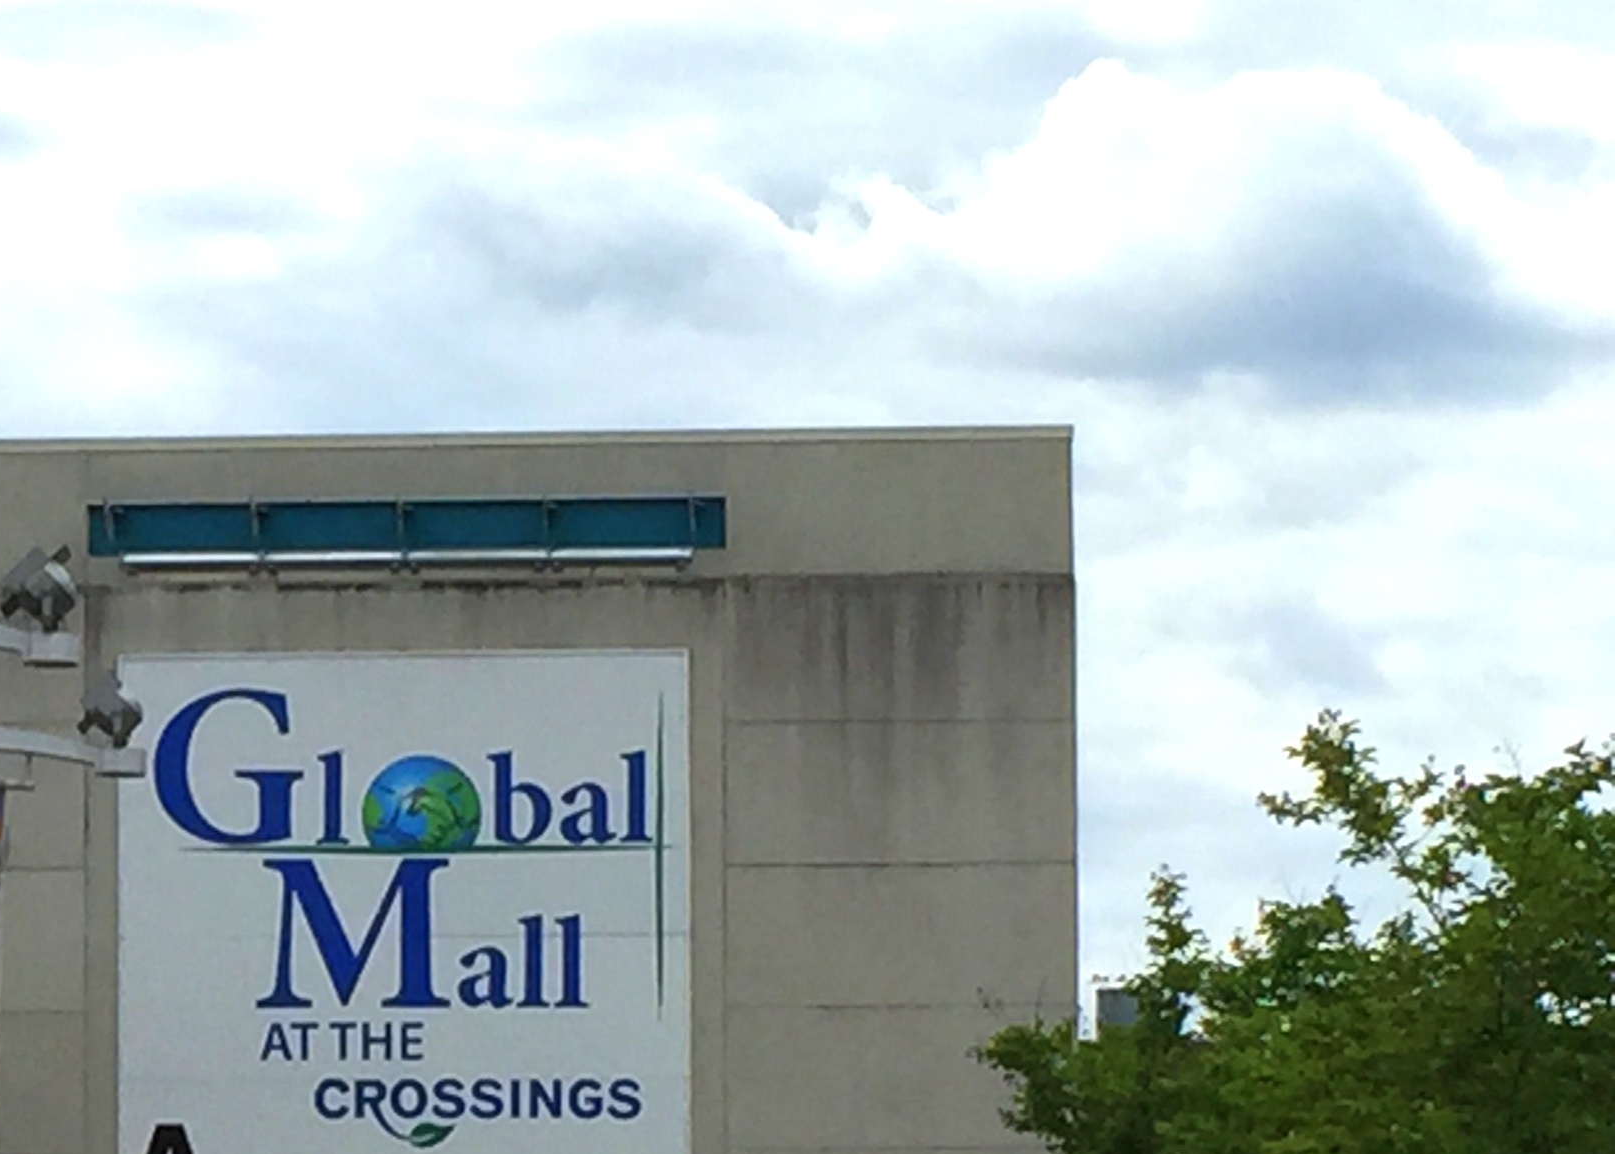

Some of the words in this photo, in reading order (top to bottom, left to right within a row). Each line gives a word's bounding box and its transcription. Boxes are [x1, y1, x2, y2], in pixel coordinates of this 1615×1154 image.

[153, 688, 654, 851] Global
[255, 857, 591, 1010] Mall
[260, 1022, 319, 1062] AT
[330, 1022, 426, 1062] THE
[313, 1078, 643, 1124] CROSSINGS
